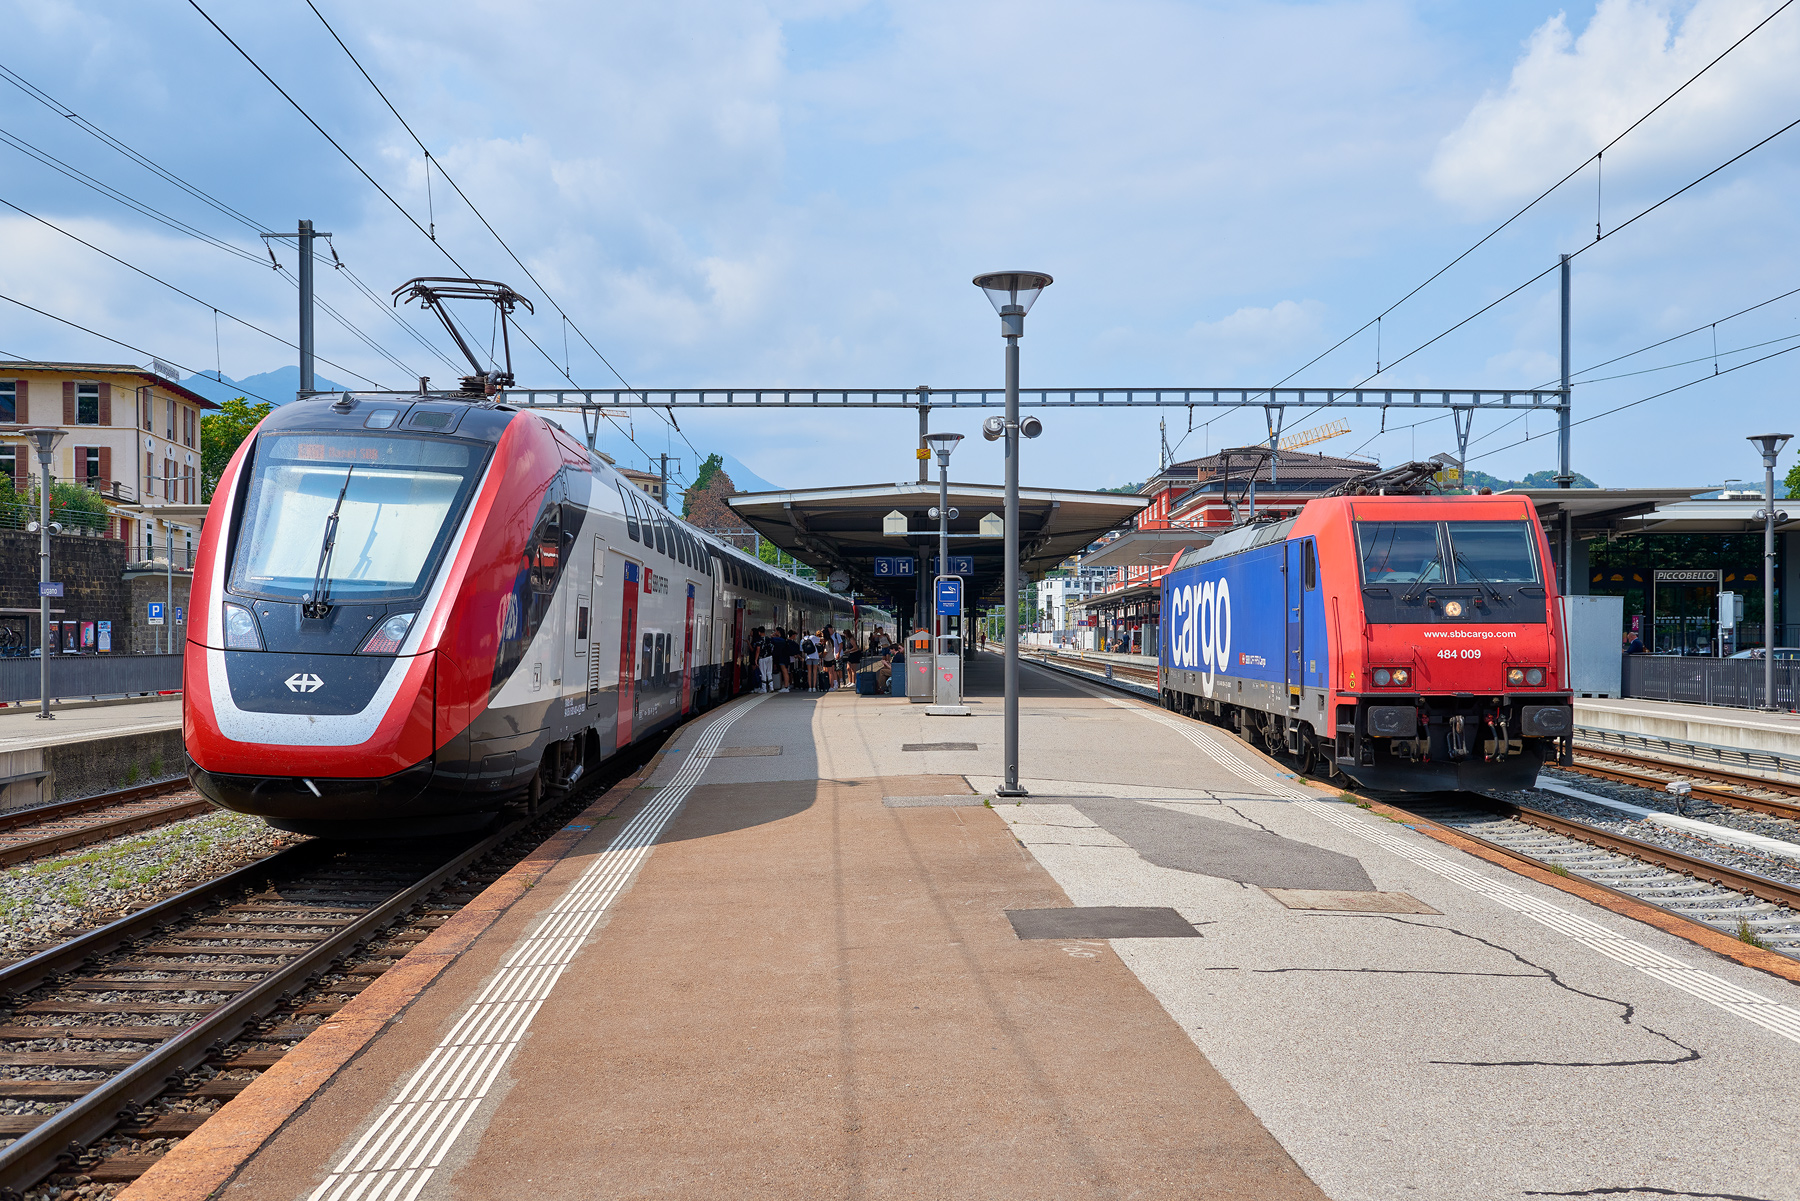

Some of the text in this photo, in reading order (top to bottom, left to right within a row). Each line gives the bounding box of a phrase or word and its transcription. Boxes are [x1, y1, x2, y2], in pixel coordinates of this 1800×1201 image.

[880, 562, 888, 573] 3
[900, 562, 909, 573] H
[960, 562, 968, 572] 2
[1657, 572, 1715, 580] PICCOBELLO
[40, 586, 58, 596] Lugano
[152, 605, 160, 617] P
[177, 609, 182, 619] P
[1171, 577, 1231, 698] cargo
[1423, 630, 1517, 640] www.sbbcargo.com
[1436, 649, 1482, 659] 484 009
